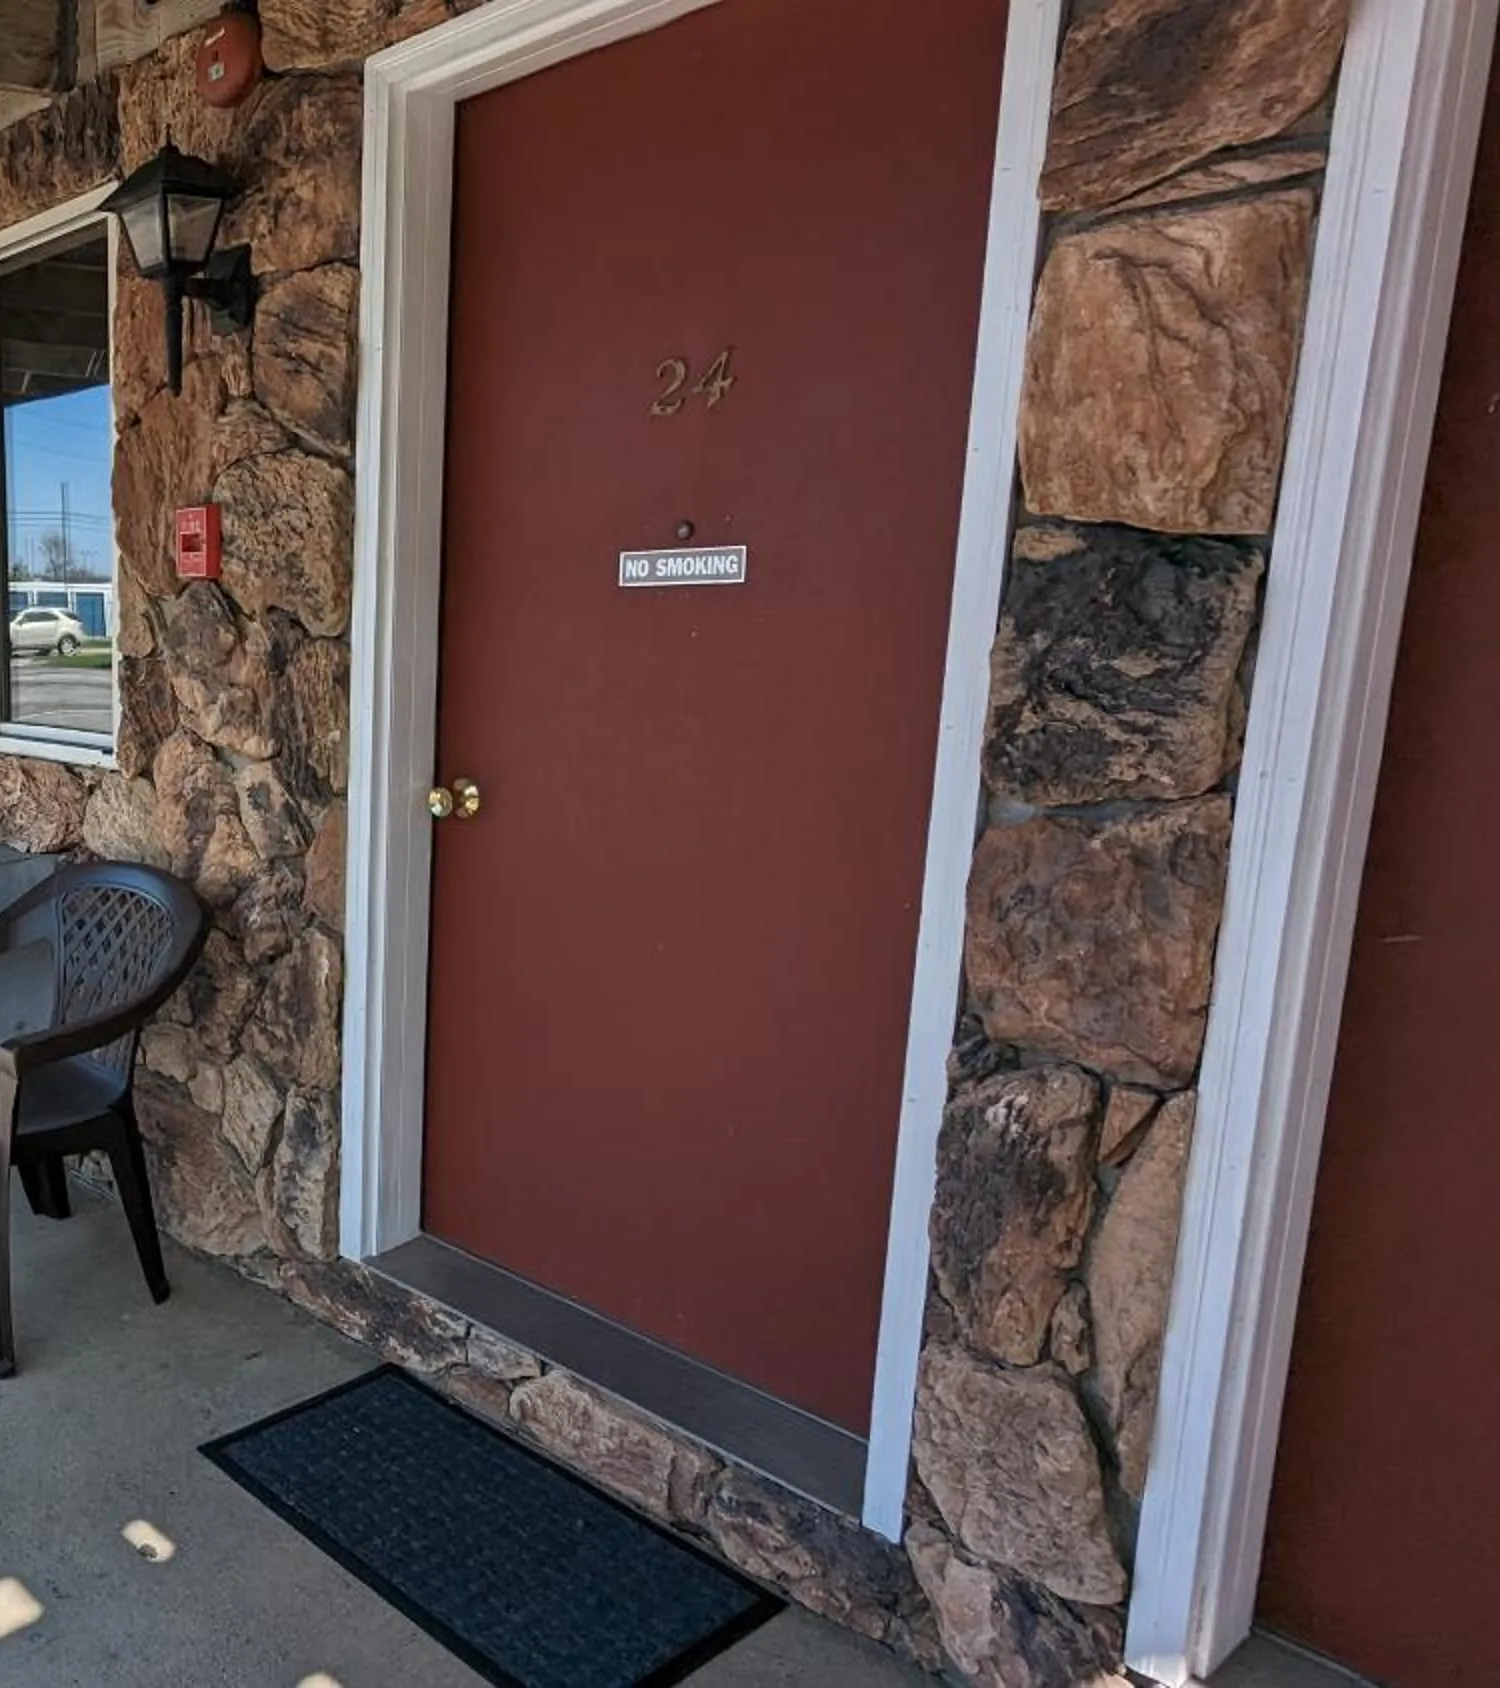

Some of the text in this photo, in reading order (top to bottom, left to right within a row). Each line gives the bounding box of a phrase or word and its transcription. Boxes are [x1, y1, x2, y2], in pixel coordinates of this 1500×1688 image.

[650, 348, 736, 416] 24
[625, 555, 739, 578] NO SMOKING
